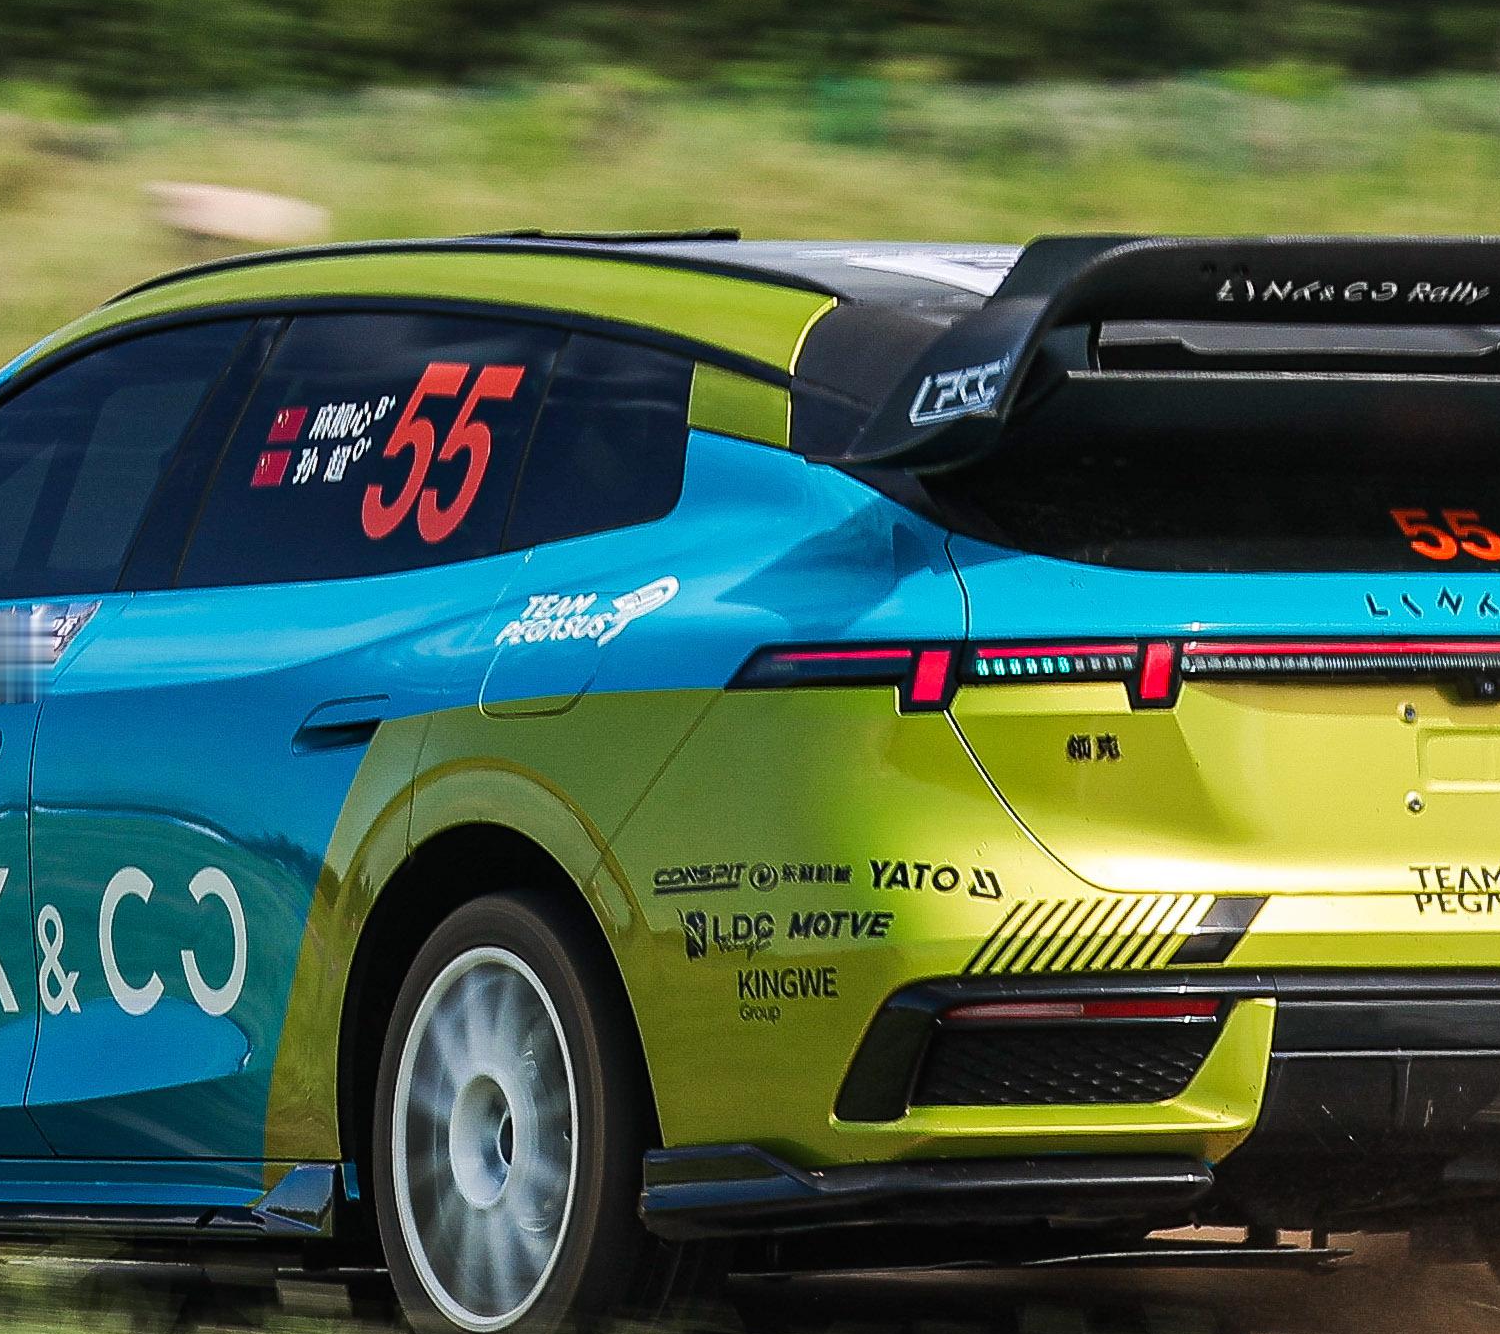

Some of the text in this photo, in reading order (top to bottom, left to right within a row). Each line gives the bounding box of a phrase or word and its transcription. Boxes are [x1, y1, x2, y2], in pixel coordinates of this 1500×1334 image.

[1407, 281, 1490, 306] Rally
[361, 361, 526, 545] 55
[520, 592, 598, 620] TEAM
[869, 860, 960, 893] YATO
[737, 967, 839, 1000] KINGWE
[739, 1003, 782, 1023] Group
